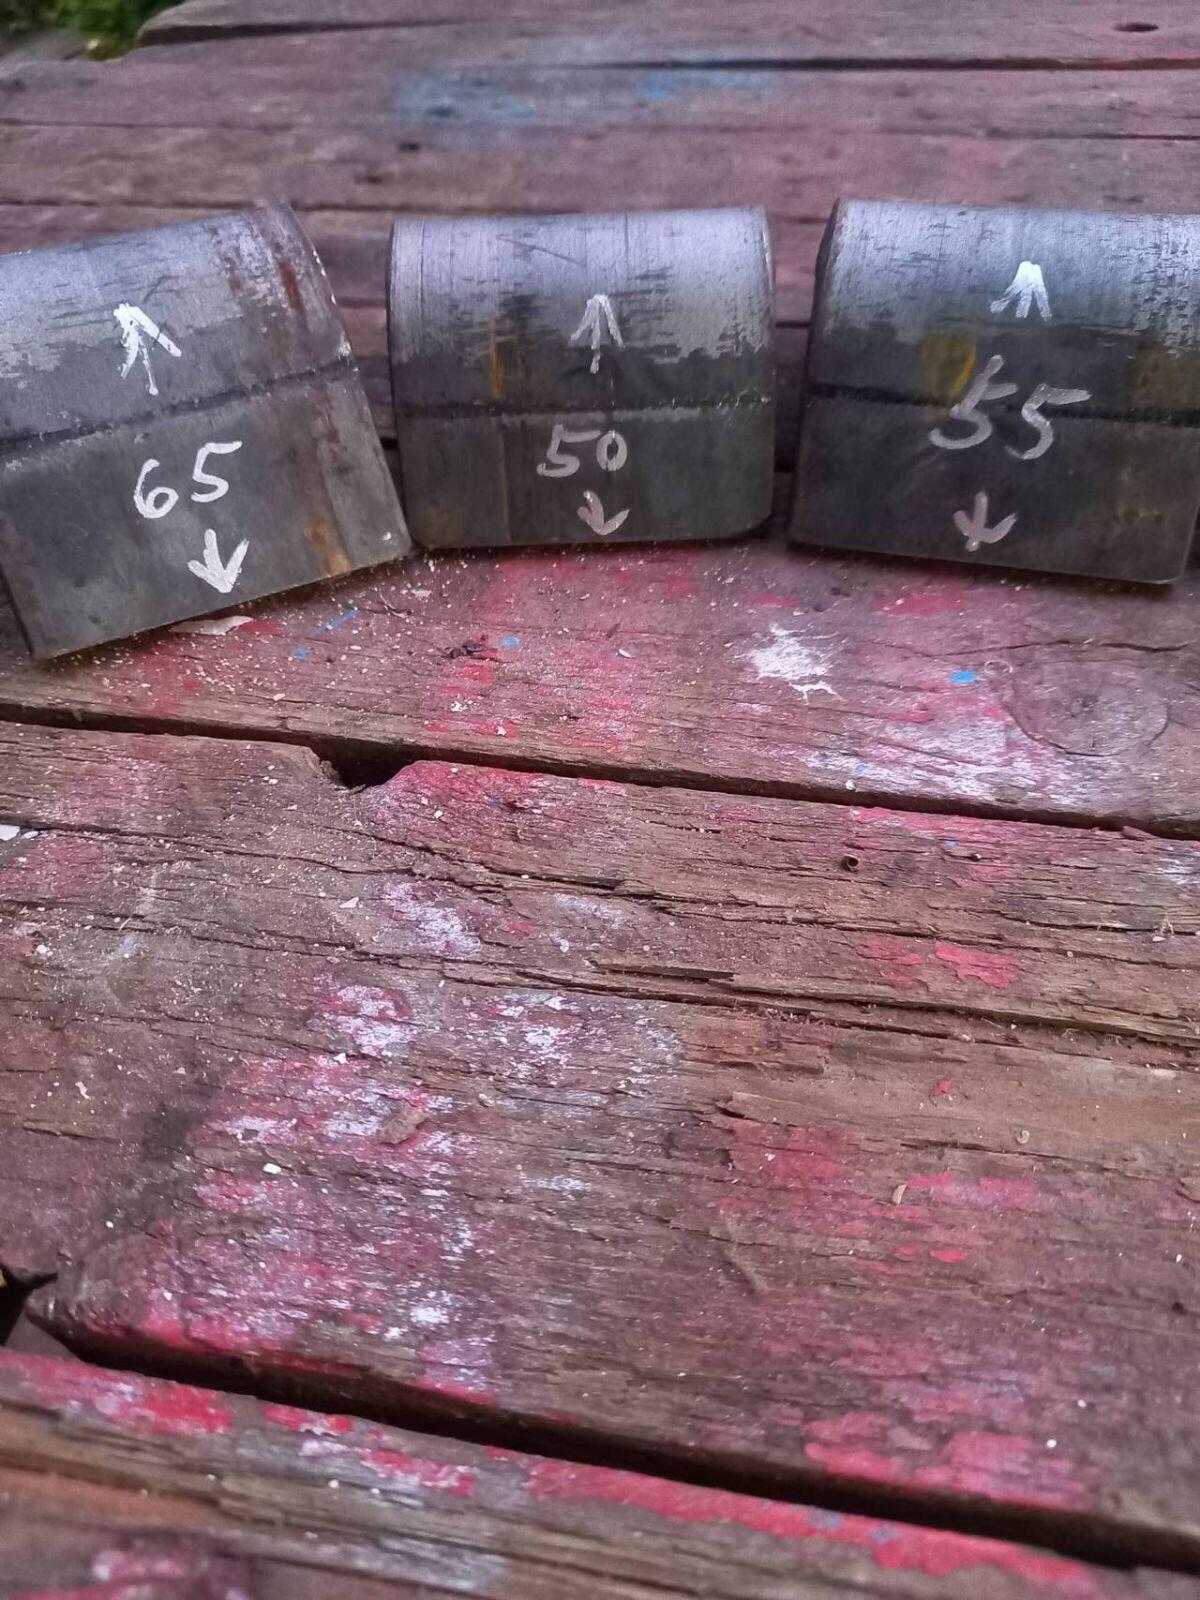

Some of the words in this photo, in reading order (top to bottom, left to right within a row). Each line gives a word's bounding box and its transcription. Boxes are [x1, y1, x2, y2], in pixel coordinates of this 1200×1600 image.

[928, 354, 1092, 460] 55
[133, 440, 243, 519] 65
[536, 424, 628, 478] 50
